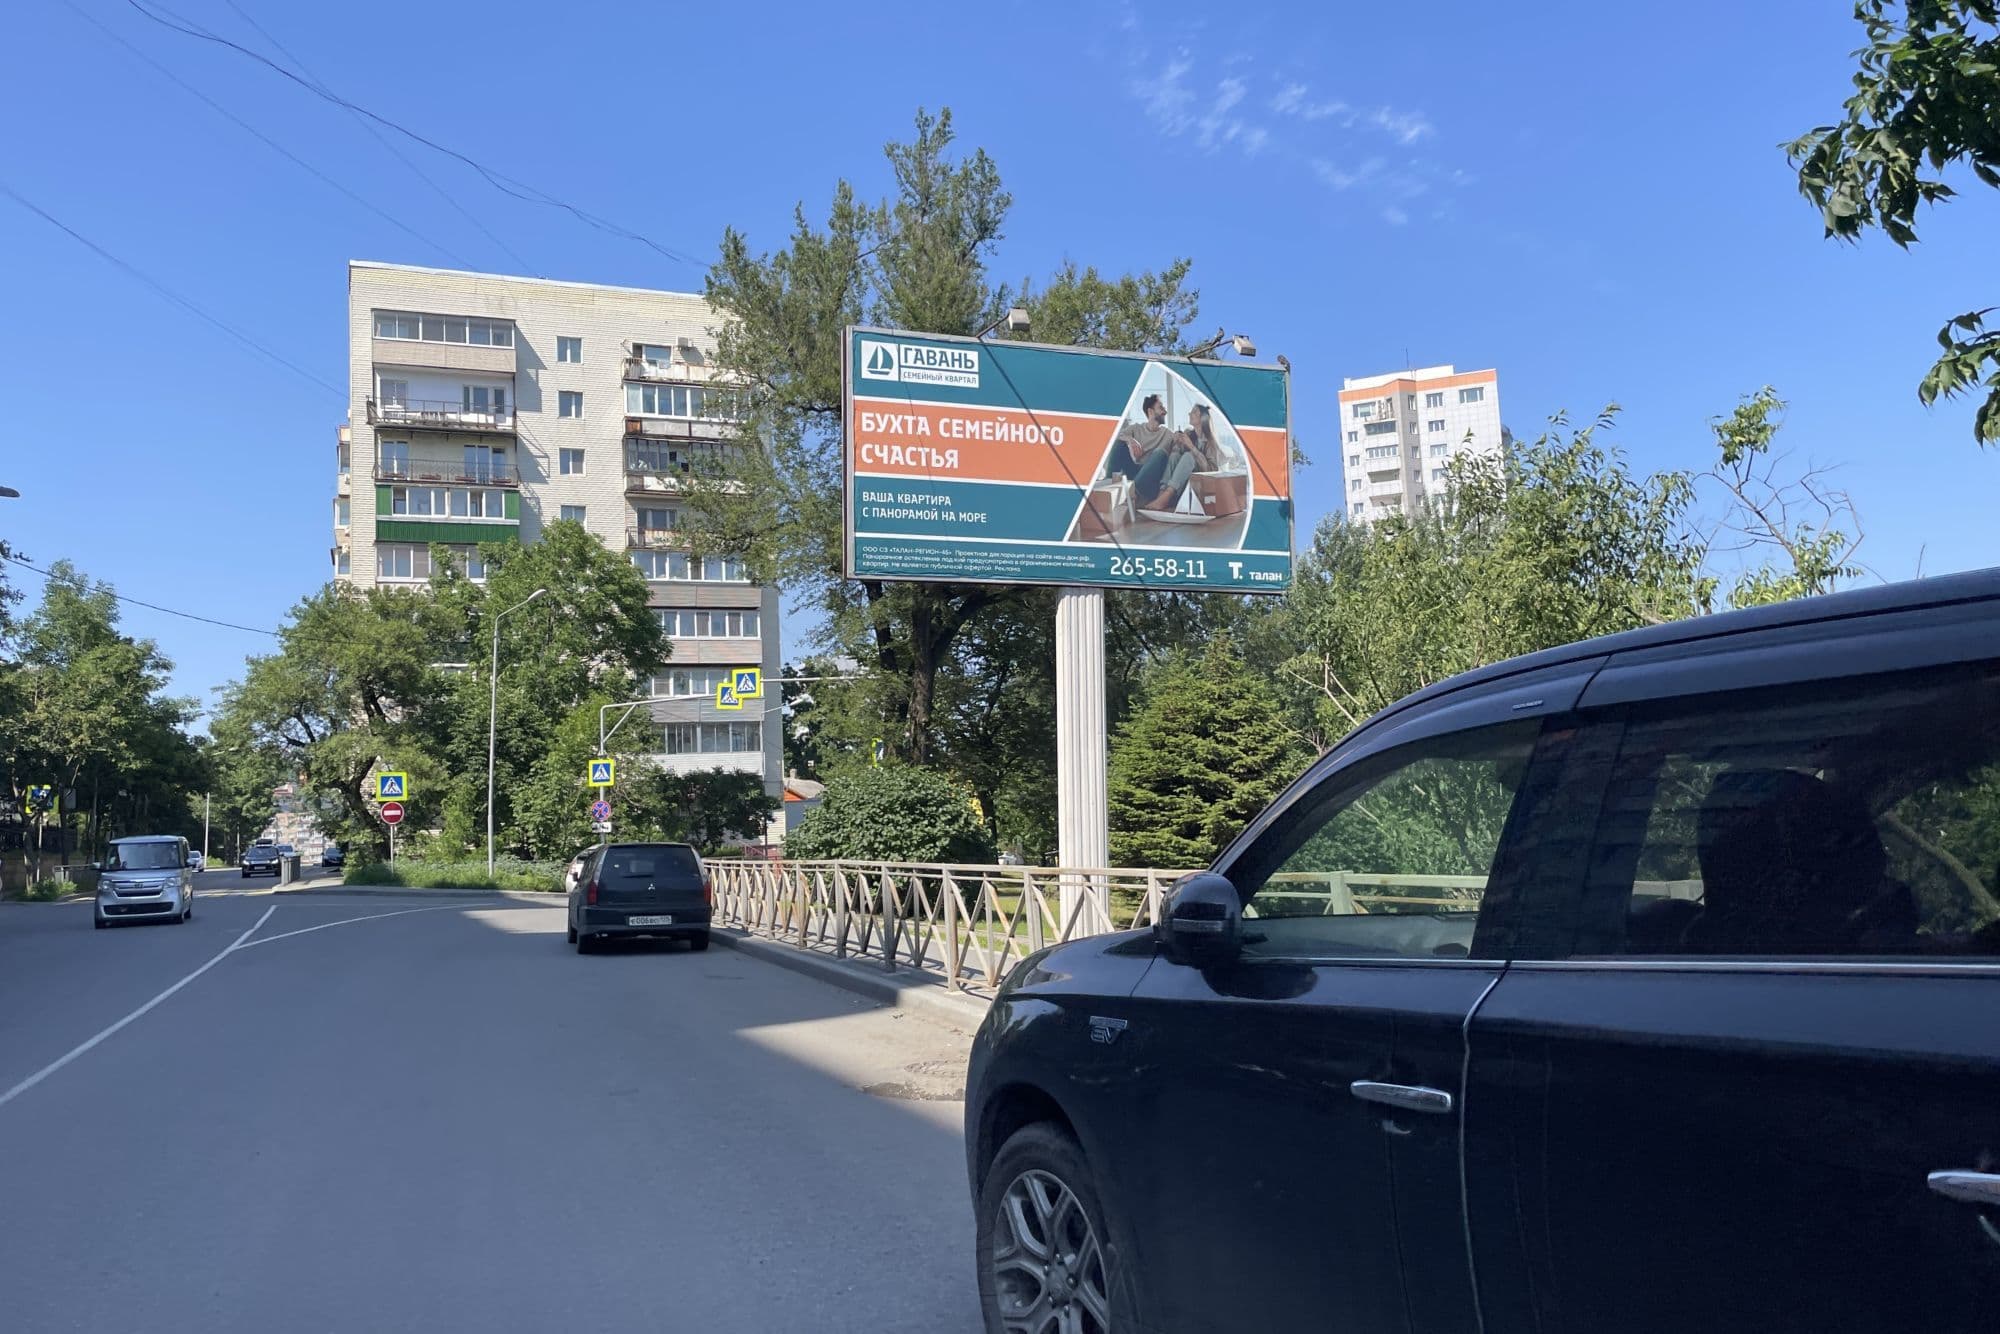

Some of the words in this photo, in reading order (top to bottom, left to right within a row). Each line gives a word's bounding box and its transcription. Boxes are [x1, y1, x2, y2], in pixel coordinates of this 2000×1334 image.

[903, 347, 975, 369] ГАВАНЬ
[903, 371, 943, 382] СЕМЕЙНЫЙ
[944, 374, 977, 384] КВАРТАЛ
[861, 412, 930, 437] БУХТА
[938, 416, 1064, 446] СЕМЕЙНОГО
[861, 444, 959, 468] СЧАСТЬЯ
[862, 491, 894, 503] ВАША
[897, 493, 952, 506] КВАРТИРА
[862, 507, 869, 517] С
[872, 508, 938, 521] ПАНОРАМОЙ
[941, 511, 956, 522] НА
[959, 512, 987, 523] МОРЕ
[1110, 556, 1207, 579] 265-58-11
[1249, 571, 1283, 582] талан
